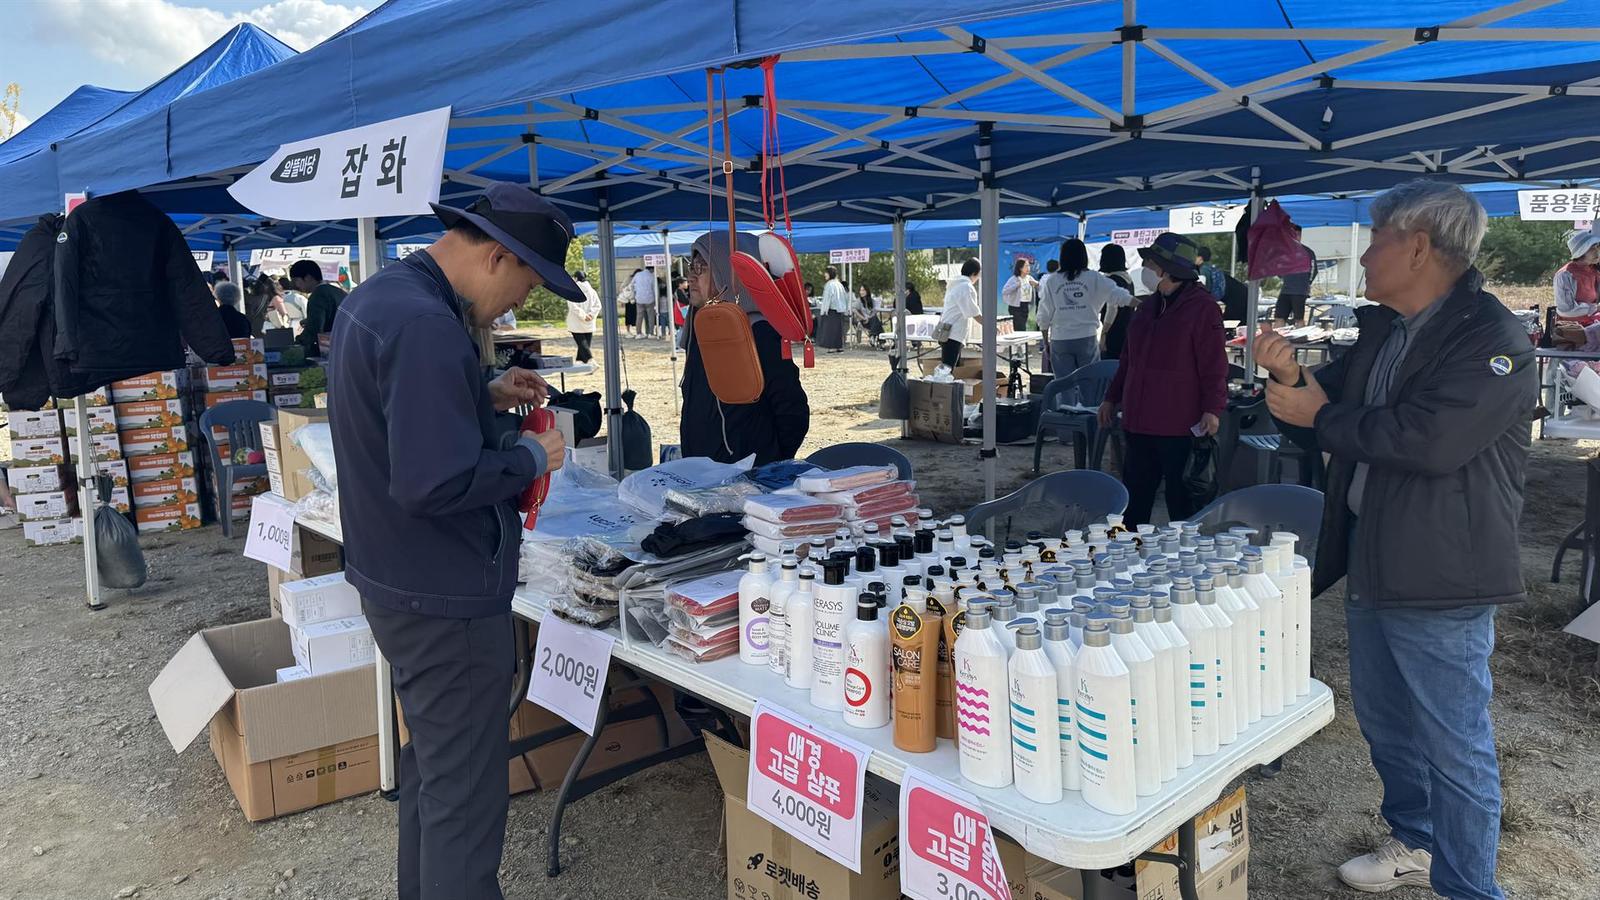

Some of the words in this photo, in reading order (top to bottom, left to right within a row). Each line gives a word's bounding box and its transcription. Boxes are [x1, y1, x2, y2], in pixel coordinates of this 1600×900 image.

[280, 153, 317, 178] 알뜰마당
[341, 135, 407, 199] 잡화
[258, 521, 289, 551] 1,000원
[541, 646, 599, 700] 2,000원
[893, 646, 920, 660] SALON
[897, 657, 920, 669] CARE
[788, 731, 822, 770] 애경
[767, 747, 799, 785] 고급
[807, 767, 841, 805] 샴푸
[772, 789, 832, 841] 4,000원
[926, 827, 971, 872] 고급
[765, 858, 821, 900] 로켓배송
